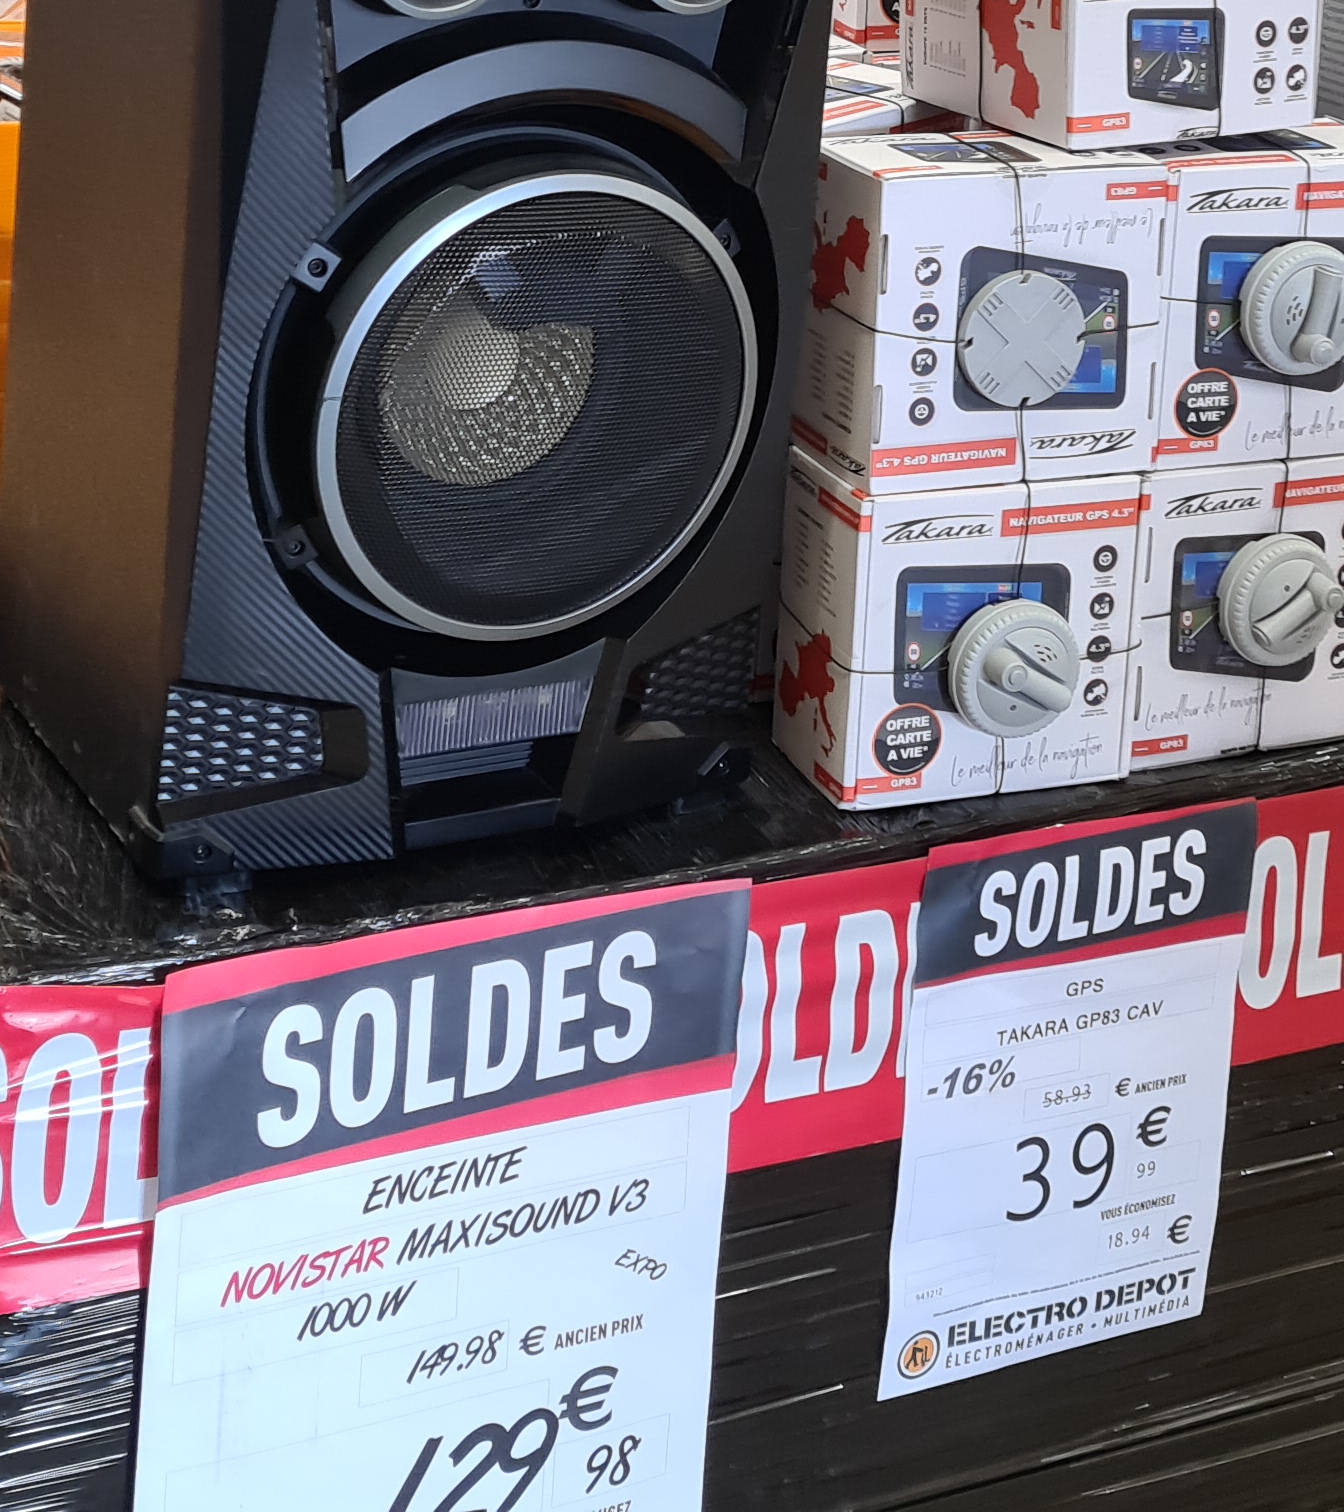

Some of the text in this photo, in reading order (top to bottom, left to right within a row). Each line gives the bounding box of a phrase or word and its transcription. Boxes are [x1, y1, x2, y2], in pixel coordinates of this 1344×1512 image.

[1186, 186, 1291, 213] Takara
[1187, 380, 1229, 395] OFFRE
[1187, 395, 1230, 409] CARTE
[903, 452, 928, 467] GPS
[931, 447, 1006, 465] NAVIGATEUR
[1009, 509, 1110, 527] NAVIGATEUR GPS
[886, 715, 931, 732] OFFRE
[886, 730, 932, 746] CARTE
[887, 748, 900, 762] A
[891, 776, 918, 787] GP83
[974, 828, 1207, 958] SOLDES
[1066, 978, 1105, 998] GPS
[997, 1000, 1164, 1047] TAKARA GP83 CAV
[256, 931, 656, 1149] SOLDES
[926, 1056, 1016, 1100] -16%
[1135, 1072, 1187, 1095] ANCIEN PRIX
[363, 1146, 527, 1214] ENCEINTE
[1005, 1122, 1115, 1223] 39
[1136, 1160, 1156, 1180] 99
[1100, 1204, 1122, 1221] VOUS
[220, 1178, 650, 1308] NOVISTAR MAXISOUND V3
[1107, 1214, 1193, 1250] 18.94 €
[615, 1249, 668, 1280] EXPO
[298, 1280, 417, 1342] 1000 W
[948, 1267, 1197, 1348] ELECTRO DEPOT
[945, 1294, 1191, 1369] ÉLECTROMÉNAGER MULTIMÉDIA
[407, 1314, 644, 1384] 149.98 € ANCIEN PRIX
[389, 1366, 619, 1512] 129 €
[586, 1435, 642, 1494] 98
